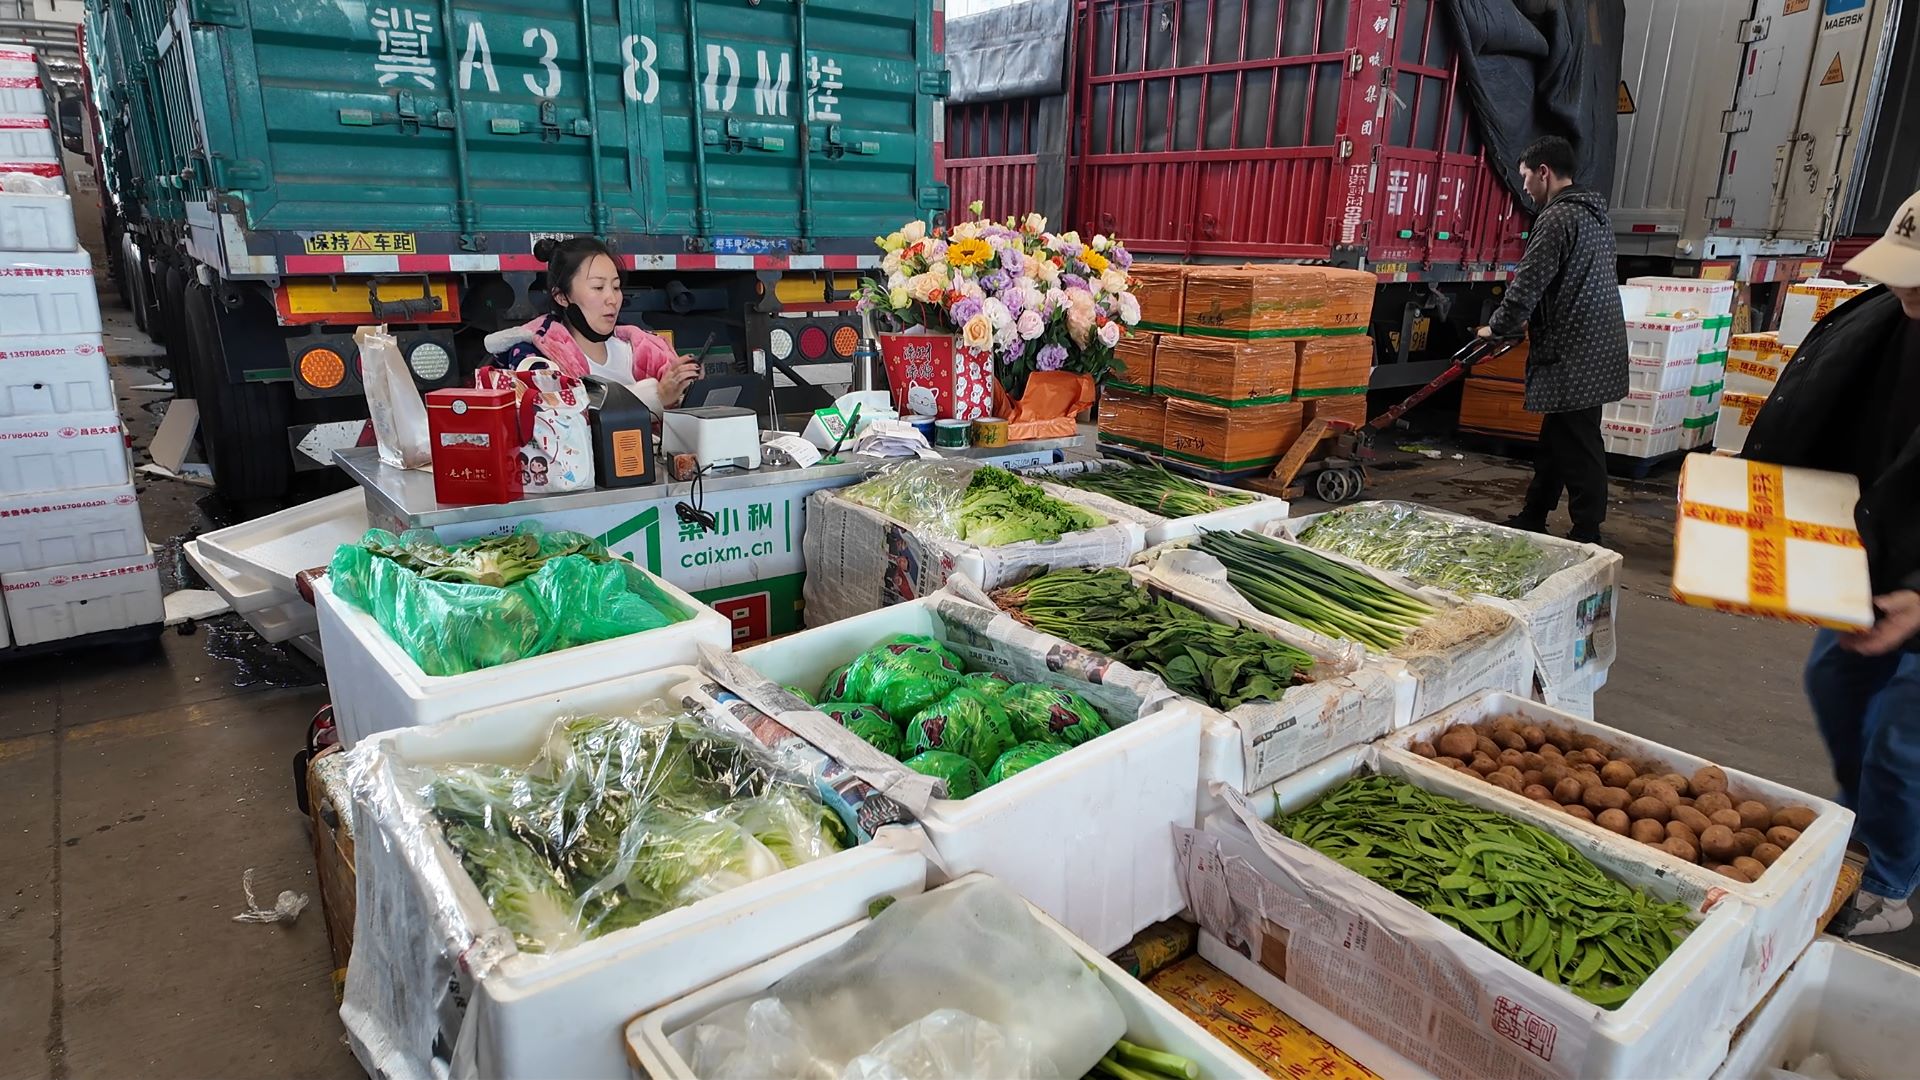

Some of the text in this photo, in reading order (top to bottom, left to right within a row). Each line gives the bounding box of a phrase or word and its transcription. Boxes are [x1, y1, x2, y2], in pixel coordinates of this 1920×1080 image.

[1824, 13, 1863, 30] MAERSK
[310, 233, 411, 250] 保持 车距
[10, 348, 66, 358] 13579840420
[680, 541, 773, 568] caixm.cn
